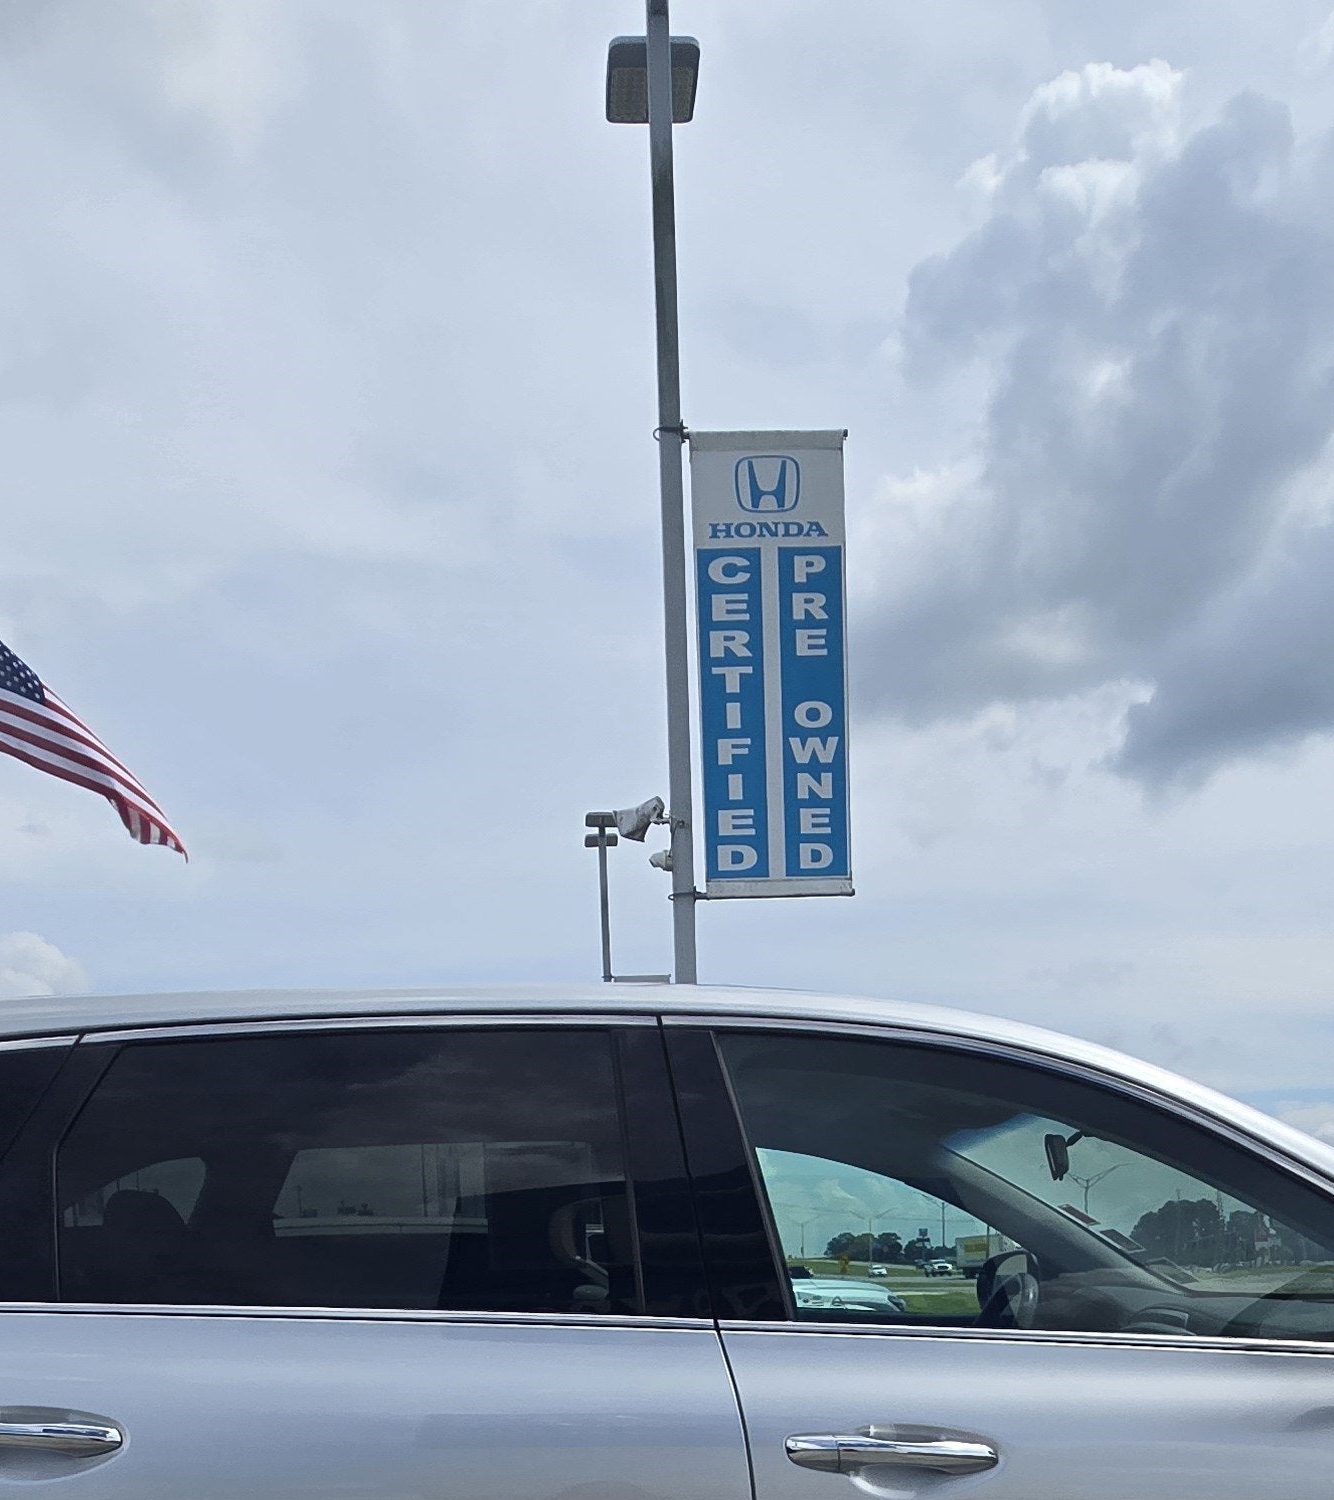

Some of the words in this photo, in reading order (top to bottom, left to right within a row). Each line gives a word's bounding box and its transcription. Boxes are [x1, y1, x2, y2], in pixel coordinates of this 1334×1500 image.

[708, 521, 829, 539] HONDA
[793, 555, 828, 657] PRE
[707, 556, 758, 872] CERTIFIED
[788, 701, 839, 870] OWNED
